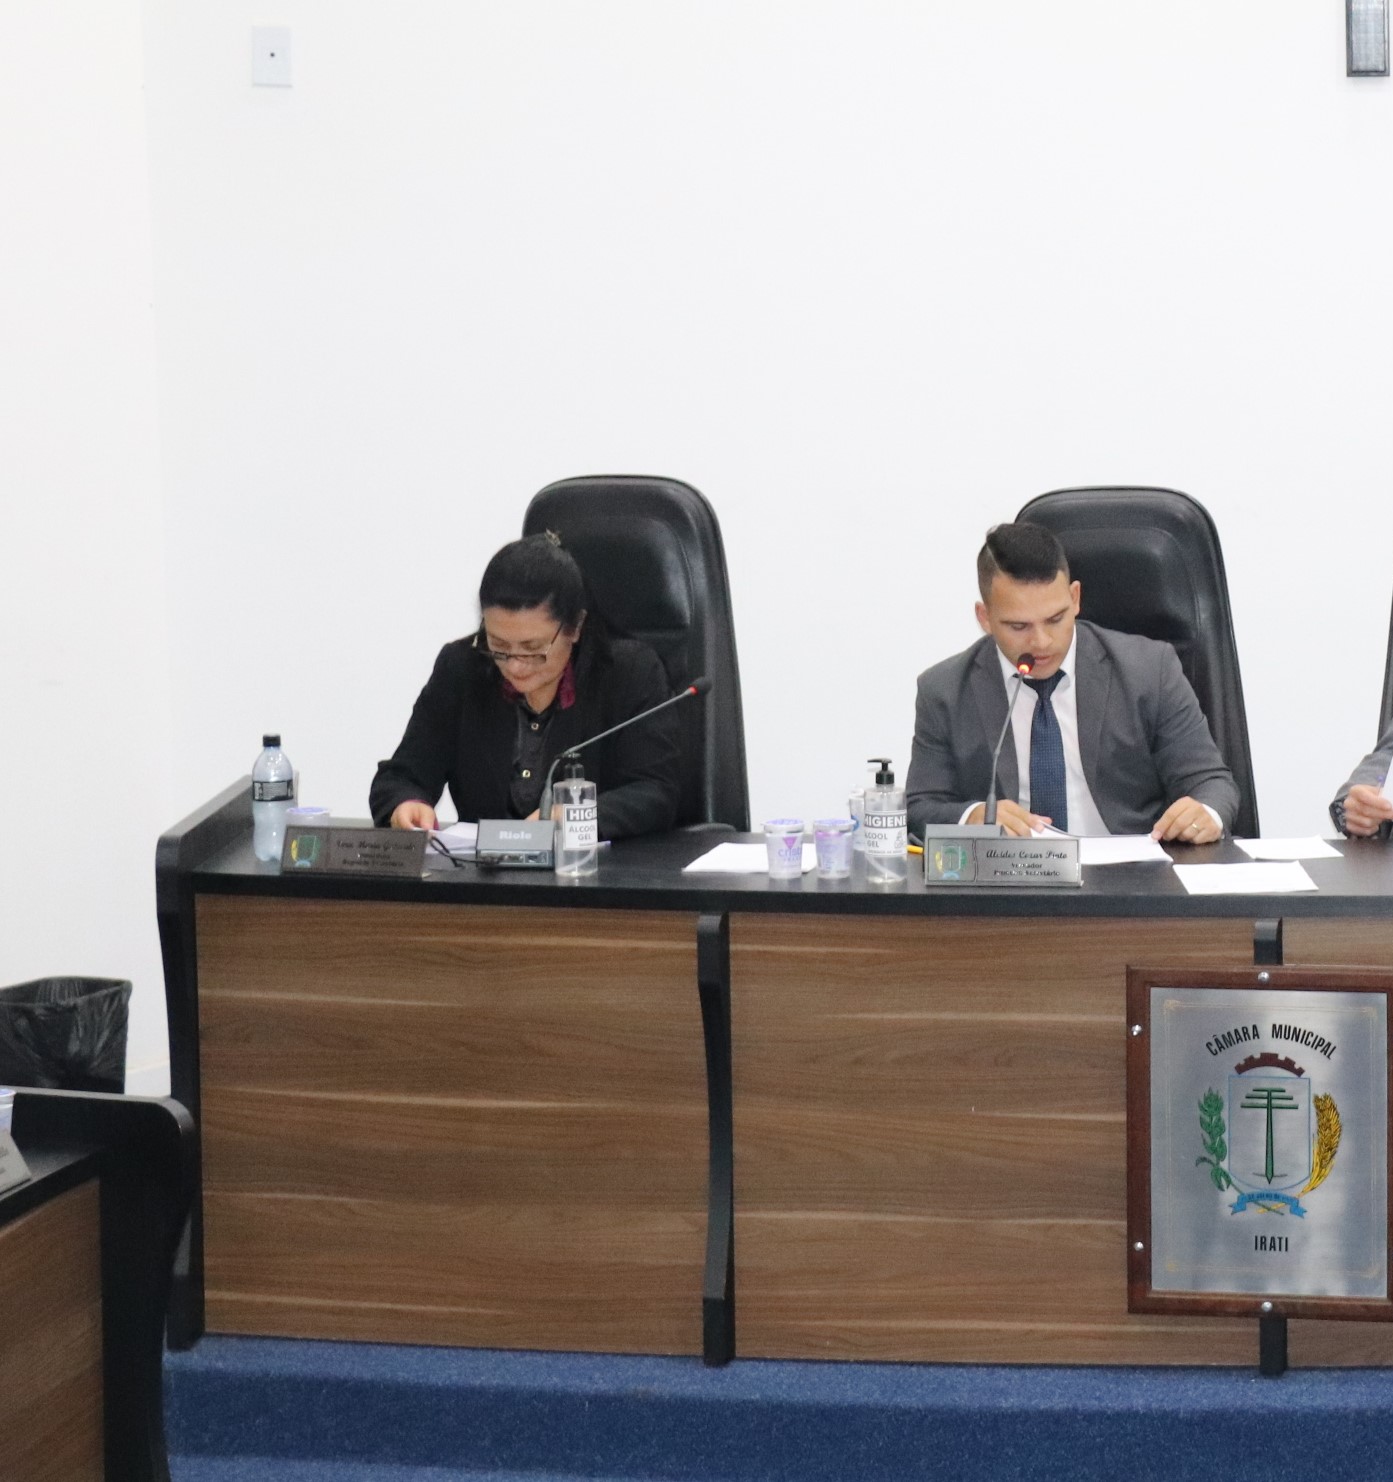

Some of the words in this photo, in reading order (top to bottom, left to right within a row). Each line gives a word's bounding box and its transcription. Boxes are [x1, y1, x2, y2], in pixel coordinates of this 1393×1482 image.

[866, 840, 880, 848] GEL
[1205, 1023, 1261, 1057] CÂMARA
[1271, 1023, 1337, 1061] MUNICIPAL
[1254, 1234, 1289, 1252] IRATI
